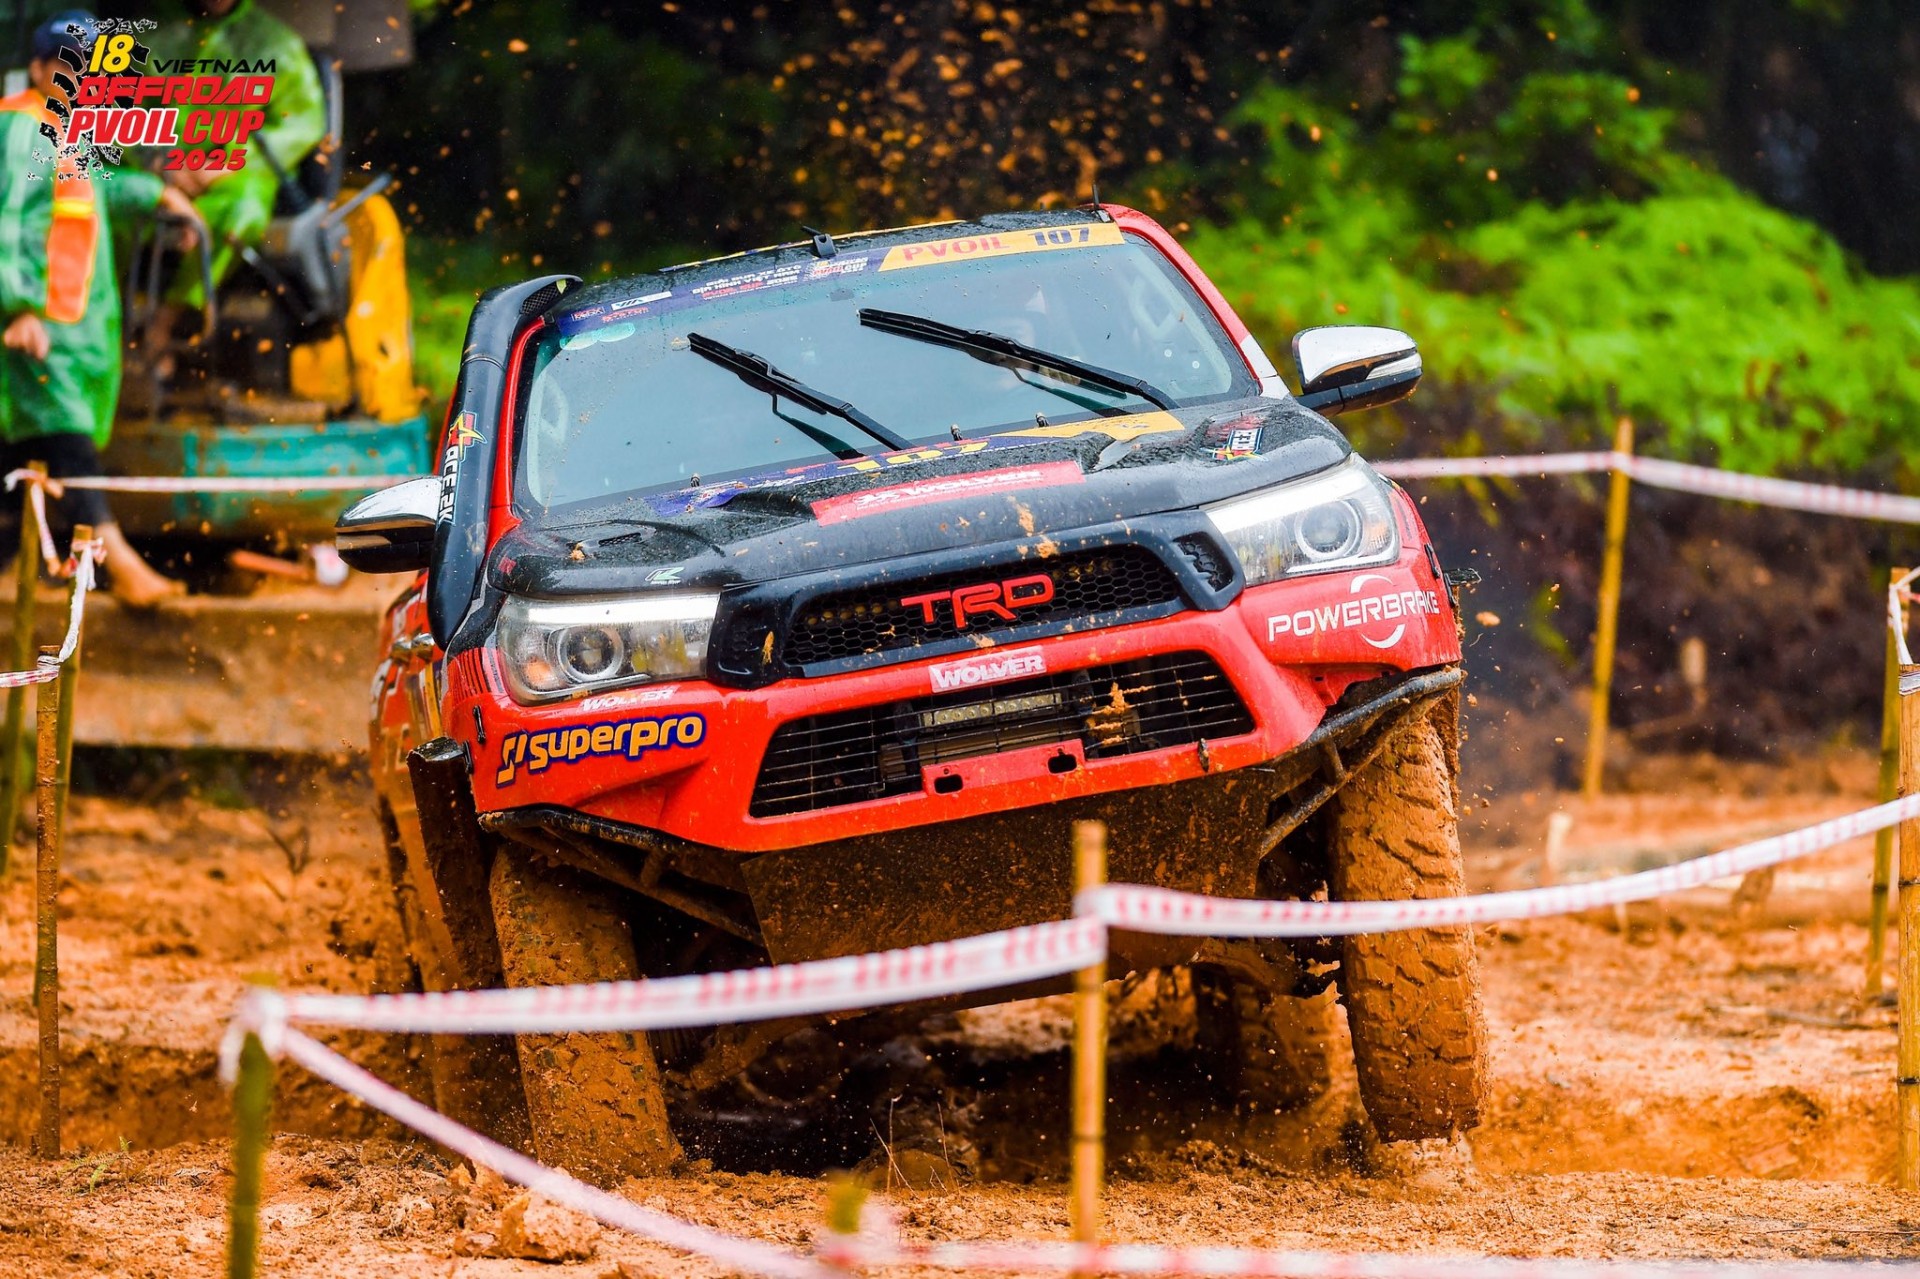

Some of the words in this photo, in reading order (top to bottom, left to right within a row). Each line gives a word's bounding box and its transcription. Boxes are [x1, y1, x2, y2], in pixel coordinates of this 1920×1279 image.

[902, 237, 1010, 262] PVOIL
[1028, 227, 1091, 246] 107
[836, 442, 990, 472] 107
[901, 574, 1054, 629] TRD
[1268, 590, 1439, 642] POWERBRAKE
[932, 654, 1044, 690] WOLVER
